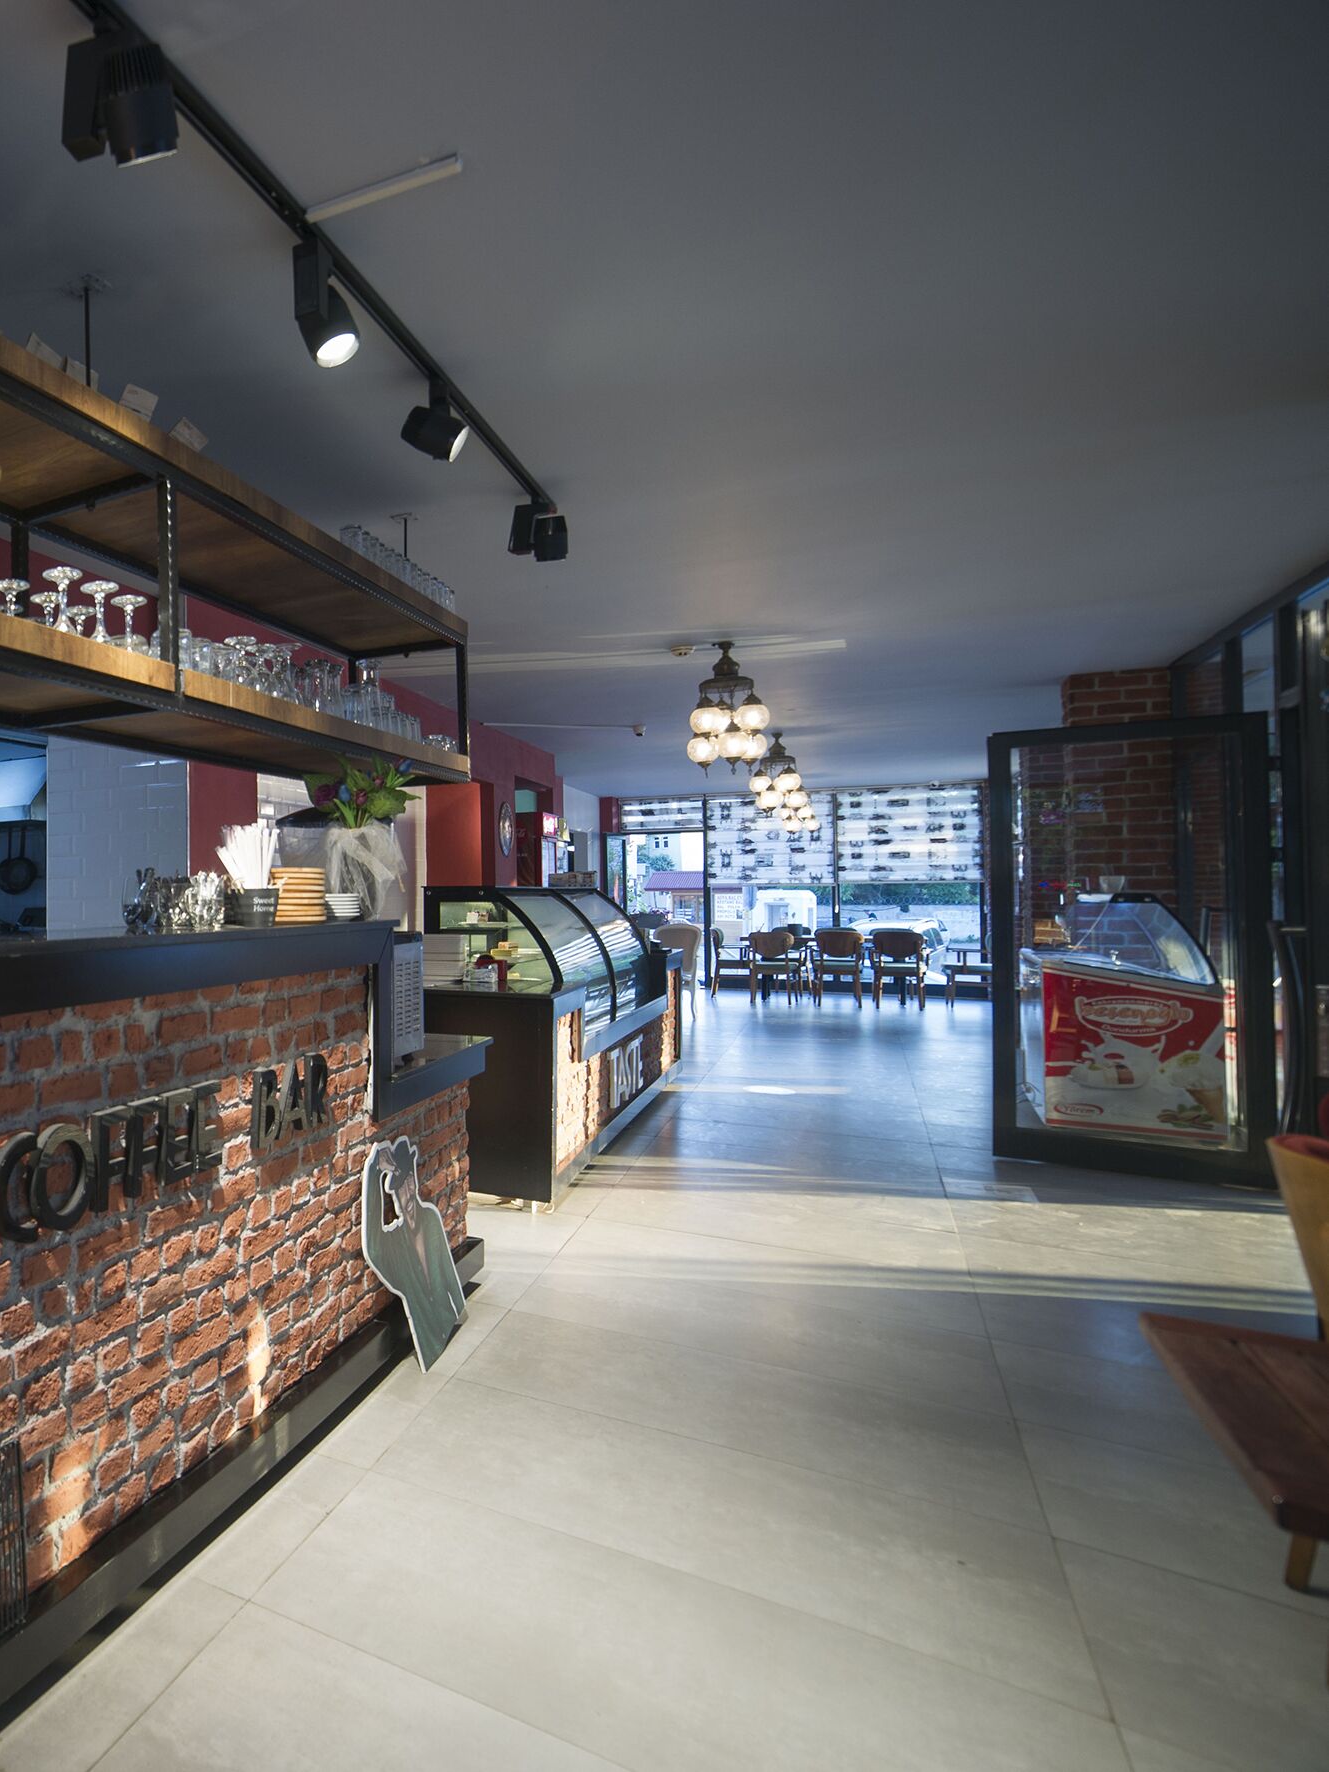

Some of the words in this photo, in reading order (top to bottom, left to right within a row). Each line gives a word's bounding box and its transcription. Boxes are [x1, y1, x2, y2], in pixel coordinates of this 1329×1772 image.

[253, 896, 274, 905] Sweet
[253, 904, 274, 912] Home
[607, 1033, 644, 1108] TASTE
[250, 1052, 329, 1152] BAR
